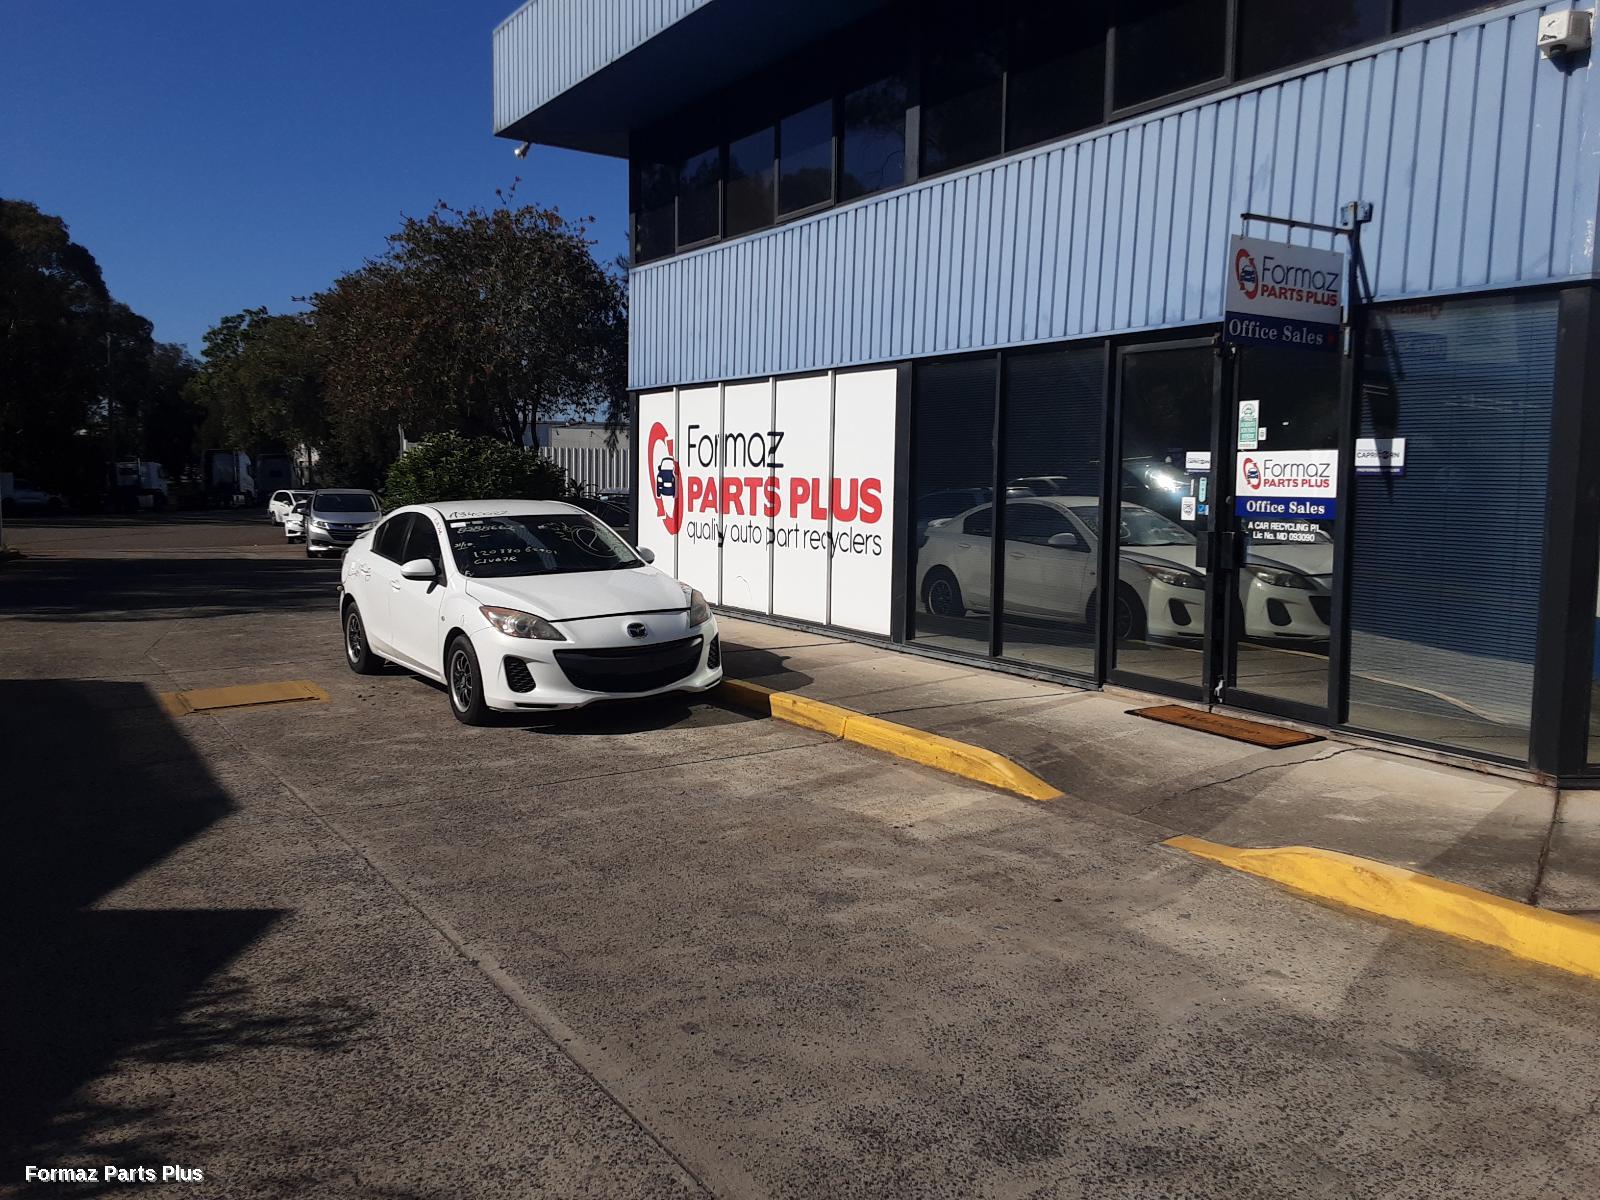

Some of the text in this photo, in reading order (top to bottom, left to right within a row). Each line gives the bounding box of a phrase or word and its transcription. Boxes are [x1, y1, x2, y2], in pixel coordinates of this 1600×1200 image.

[1261, 256, 1339, 292] Formaz
[1260, 284, 1338, 306] PARTS PLUS
[1229, 319, 1324, 345] Office Sales
[687, 424, 785, 468] Formaz
[1263, 459, 1331, 478] Formaz
[1263, 479, 1330, 488] PARTS PLUS
[687, 476, 883, 524] PARTS PLUS
[1246, 500, 1326, 515] Office Sales
[1247, 521, 1254, 529] A
[1254, 522, 1269, 530] CAR
[1270, 522, 1309, 532] RECYCLING
[1252, 531, 1264, 539] Lic
[1276, 532, 1288, 541] MD
[730, 520, 762, 544] auto
[766, 523, 800, 551] part
[803, 526, 882, 559] recyclers
